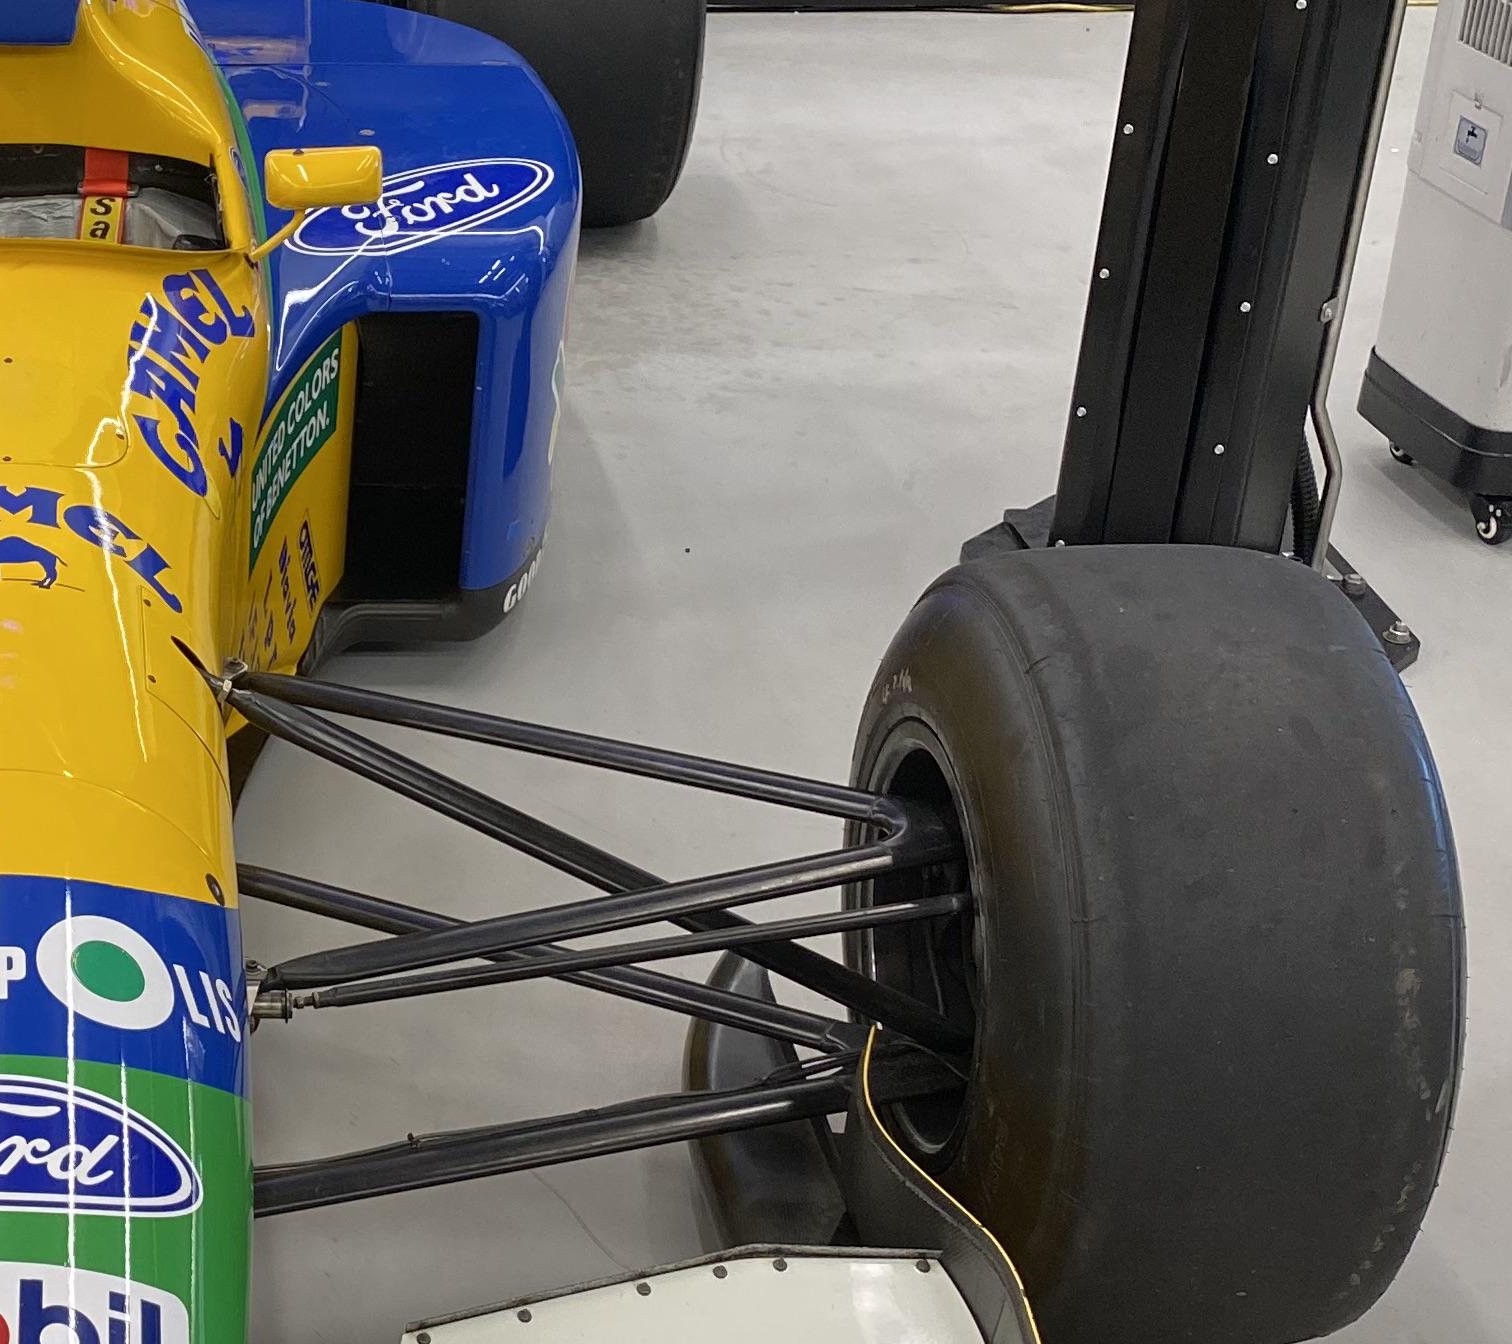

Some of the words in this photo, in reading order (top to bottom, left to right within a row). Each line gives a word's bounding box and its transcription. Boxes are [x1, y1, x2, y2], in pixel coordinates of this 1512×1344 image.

[341, 172, 500, 238] Ford
[126, 268, 256, 497] CAMEL
[252, 419, 286, 512] UNITED
[287, 347, 339, 436] COLORS
[252, 505, 264, 549] OF
